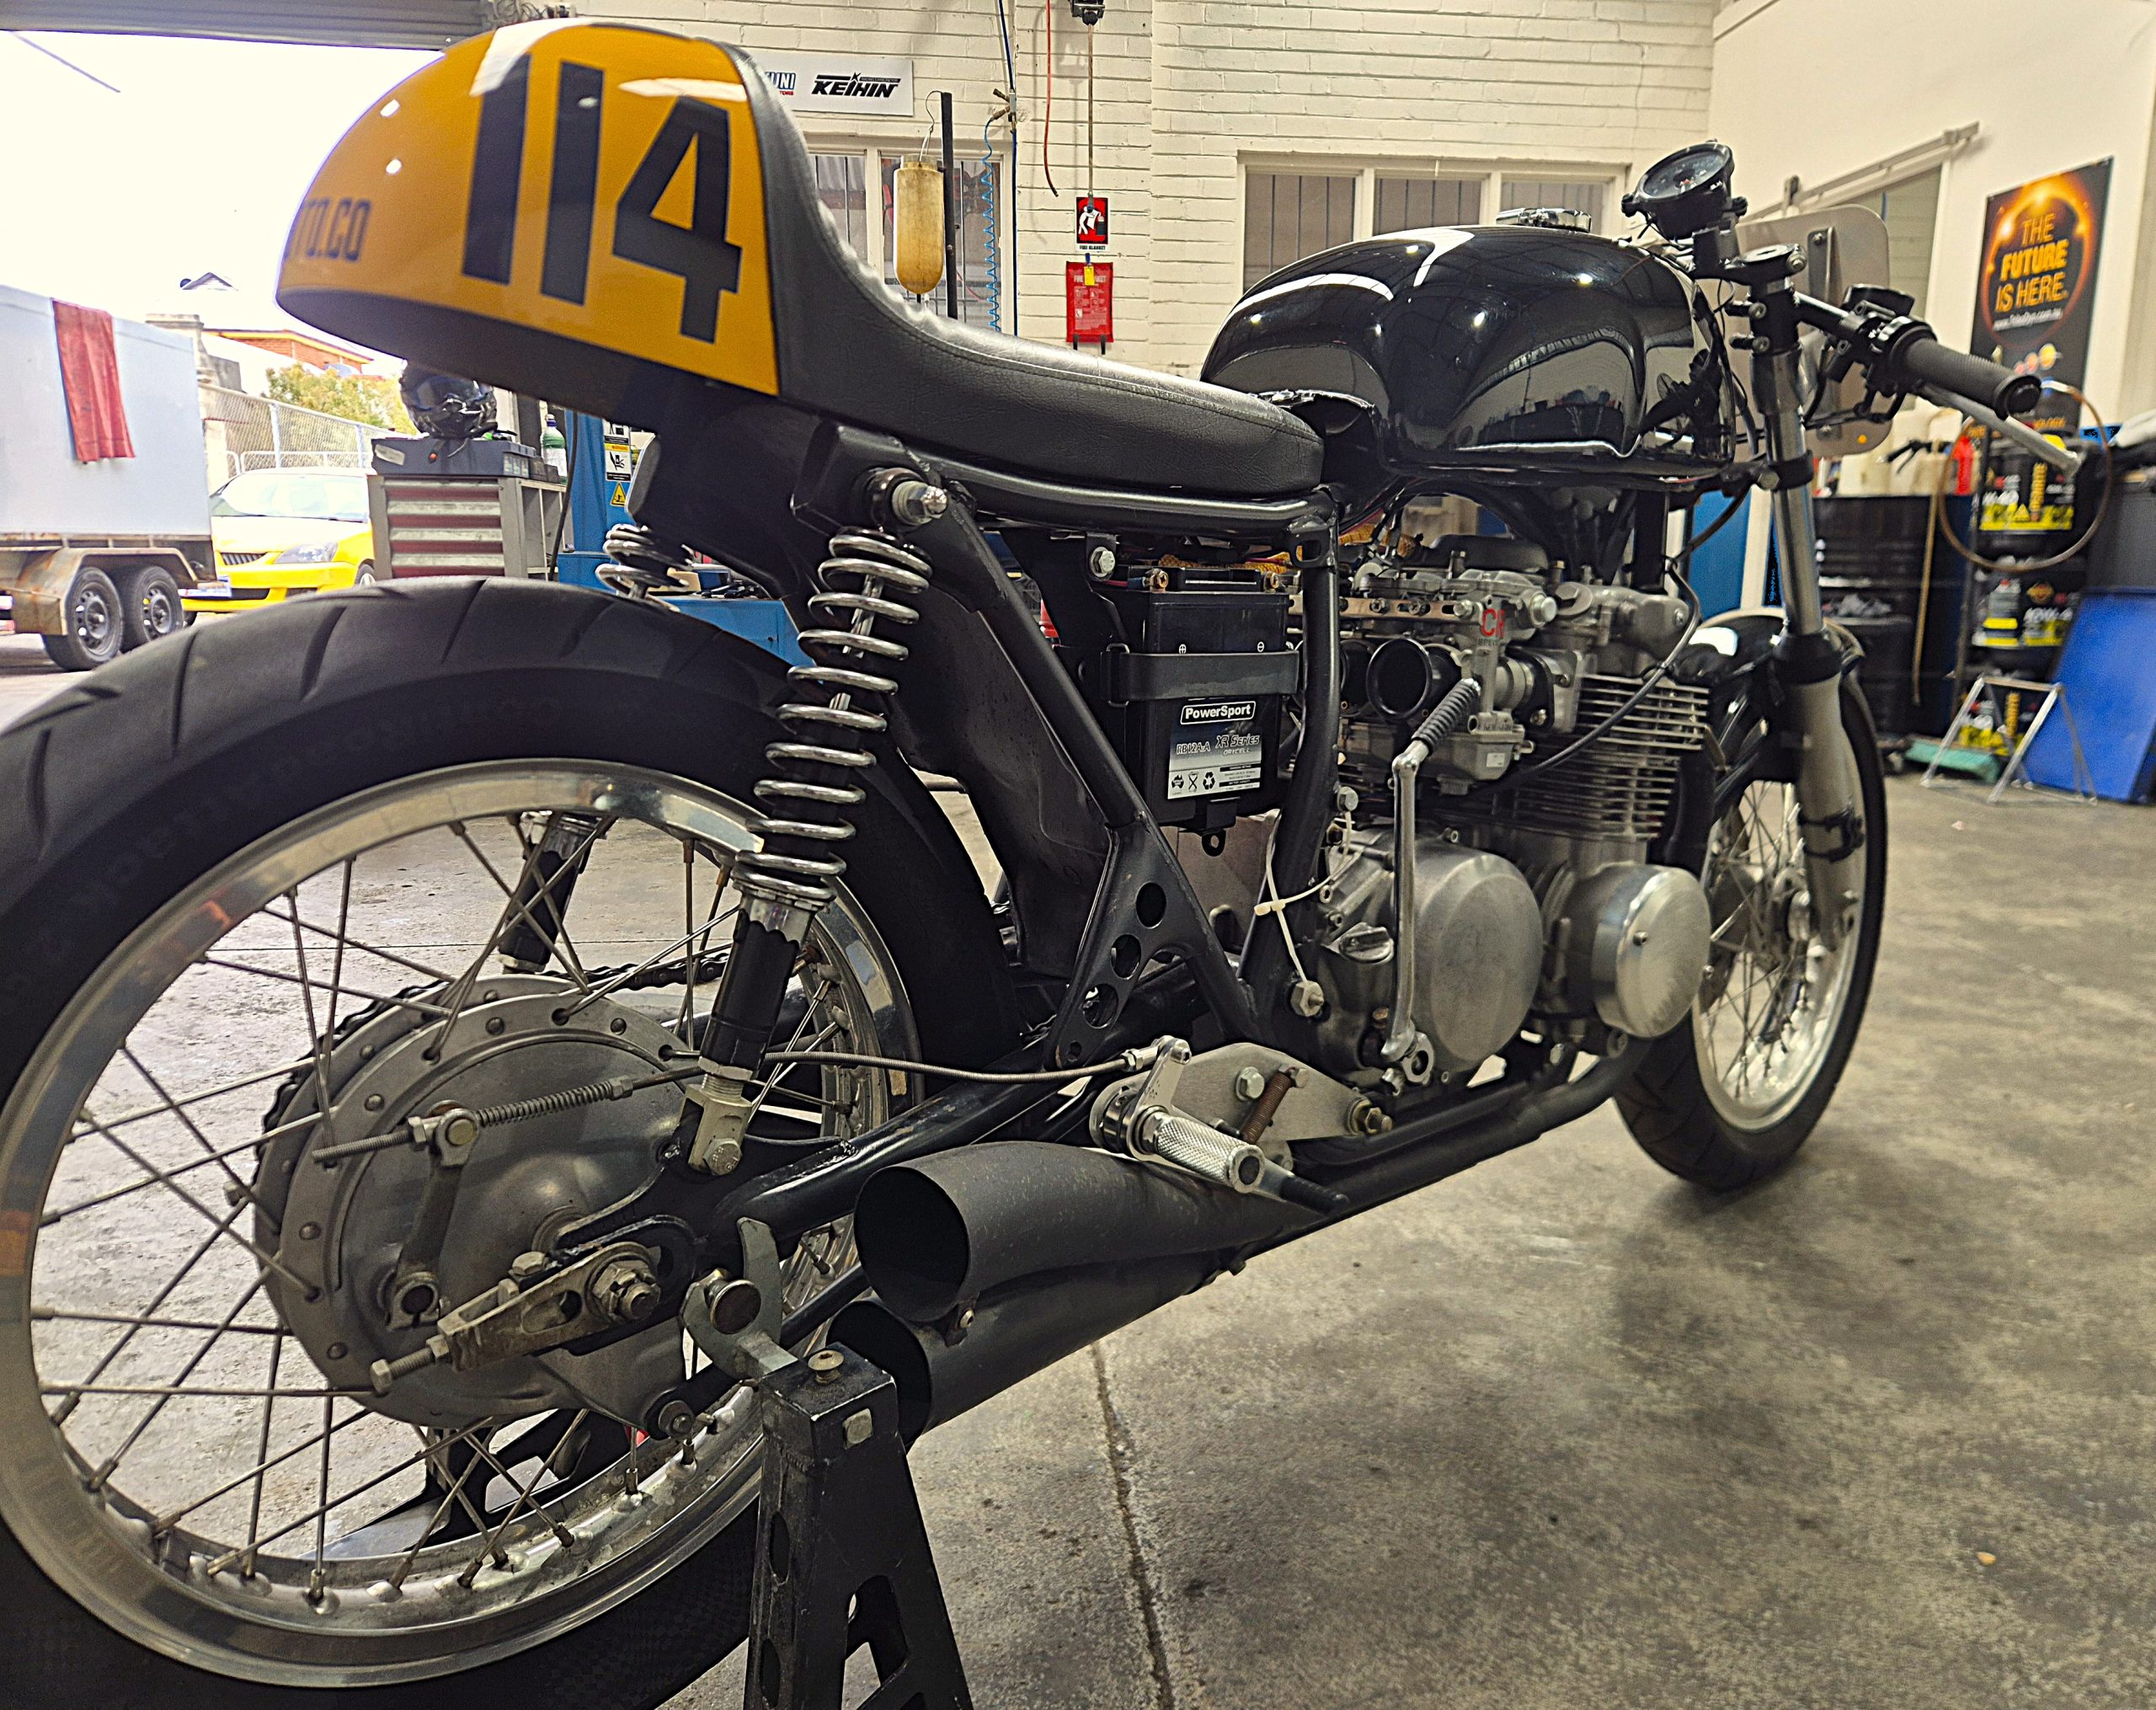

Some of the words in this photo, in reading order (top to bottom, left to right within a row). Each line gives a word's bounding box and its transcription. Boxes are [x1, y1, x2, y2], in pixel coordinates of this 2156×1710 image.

[811, 79, 899, 98] KEIHIN
[462, 53, 743, 345] 114
[2022, 212, 2055, 246] THE
[2000, 238, 2069, 281] FUTURE
[1995, 283, 2015, 313] IS
[2016, 271, 2069, 307] HERE.
[1185, 704, 1251, 719] PowerSport
[1230, 733, 1261, 747] Series
